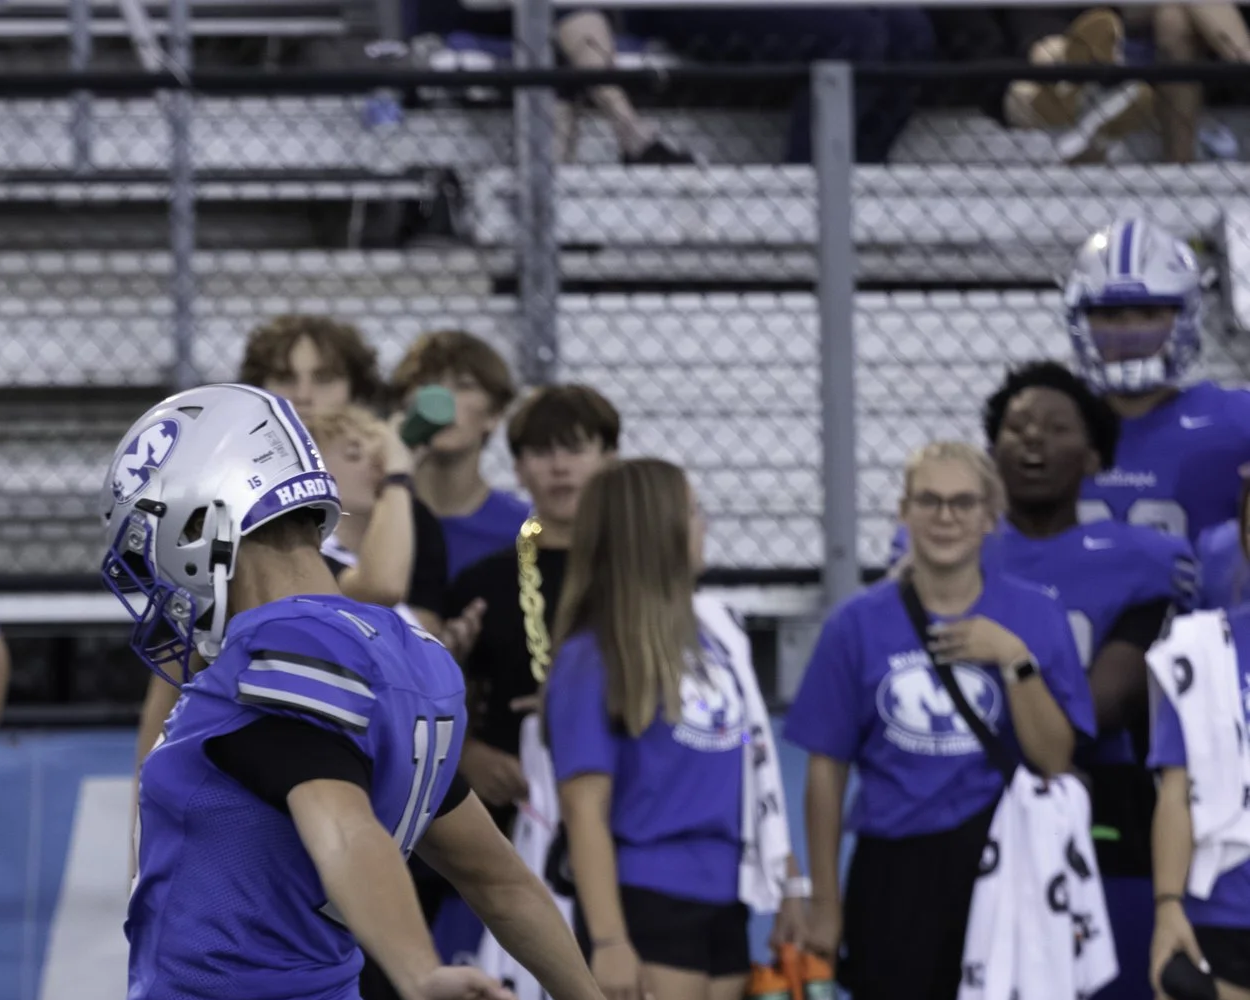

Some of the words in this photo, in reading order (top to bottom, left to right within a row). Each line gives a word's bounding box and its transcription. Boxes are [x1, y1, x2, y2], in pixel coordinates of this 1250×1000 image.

[115, 422, 174, 498] M
[247, 475, 263, 490] 15
[275, 478, 327, 505] HARD
